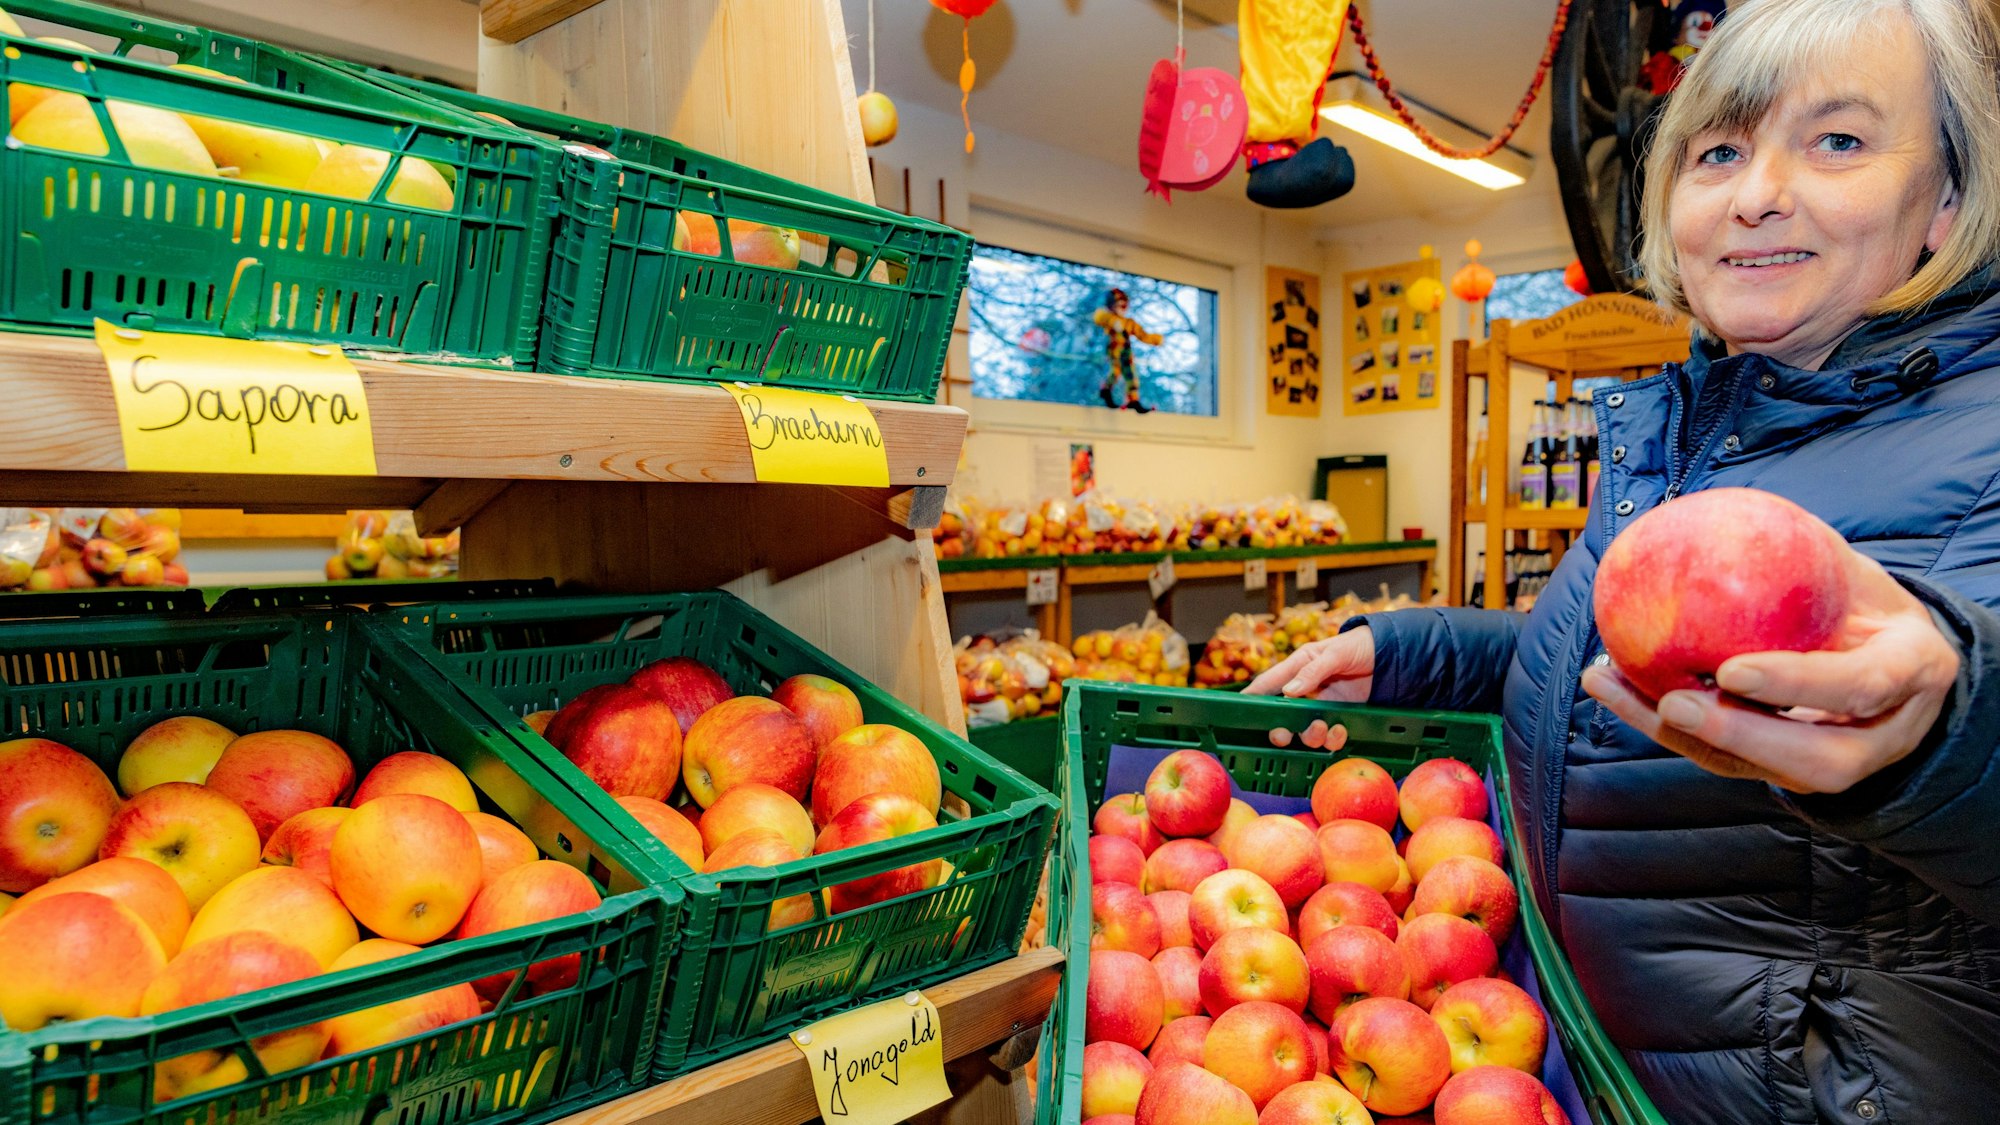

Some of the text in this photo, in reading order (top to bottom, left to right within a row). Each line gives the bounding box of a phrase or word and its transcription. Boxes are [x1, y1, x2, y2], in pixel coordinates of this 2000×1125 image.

[1532, 318, 1566, 340] BAD
[132, 355, 359, 454] Sapora
[741, 394, 881, 450] Braeburn
[823, 1007, 936, 1115] Jonagold
